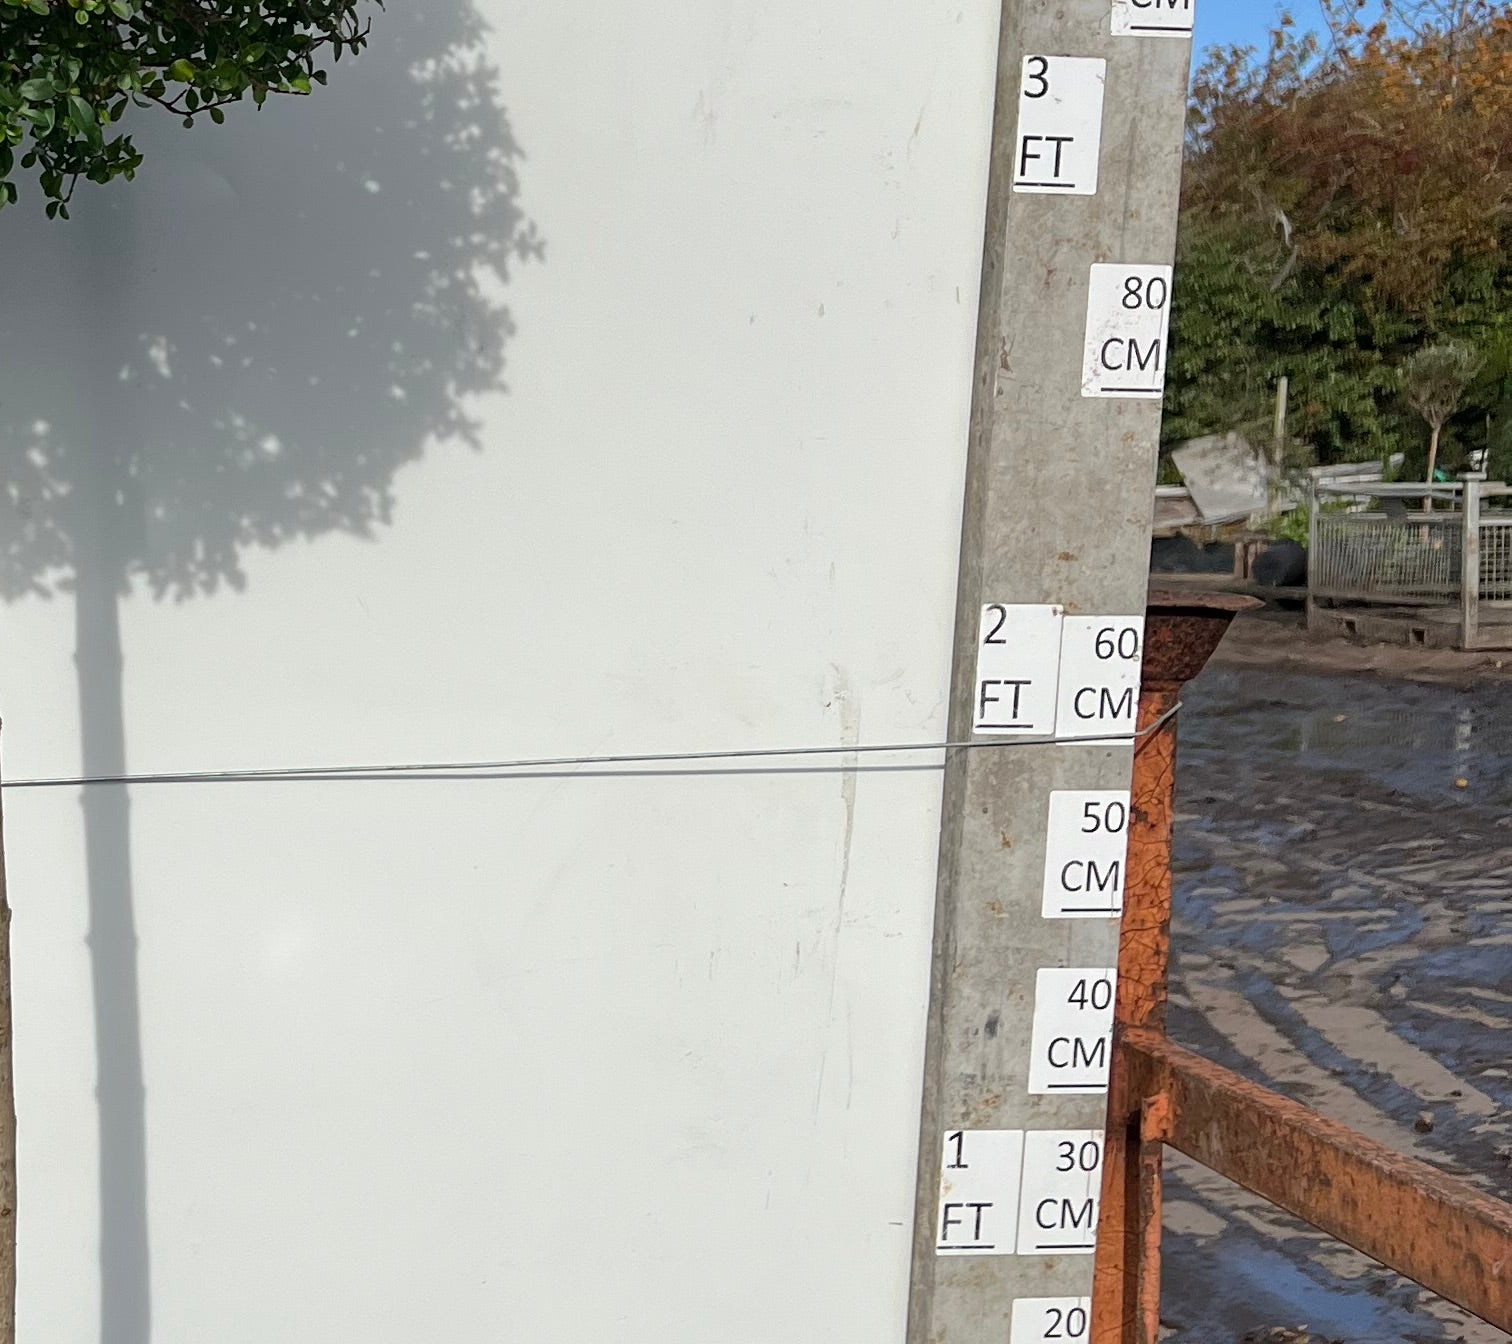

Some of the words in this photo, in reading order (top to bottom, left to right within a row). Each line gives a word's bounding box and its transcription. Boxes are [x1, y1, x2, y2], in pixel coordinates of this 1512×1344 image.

[1024, 56, 1049, 99] 3
[1019, 135, 1074, 178] FT
[1122, 276, 1167, 310] 80
[1101, 337, 1161, 372] CM
[984, 604, 1007, 644] 2
[1095, 627, 1139, 660] 60
[980, 680, 1032, 719] FT
[1074, 687, 1133, 719] CM
[1081, 801, 1125, 833] 50
[1061, 860, 1120, 892] CM
[1067, 979, 1112, 1010] 40
[1048, 1037, 1106, 1068] CM
[949, 1131, 969, 1169] 1
[1056, 1140, 1101, 1172] 30
[942, 1202, 993, 1241] FT
[1036, 1198, 1094, 1229] CM
[1043, 1307, 1086, 1338] 20
